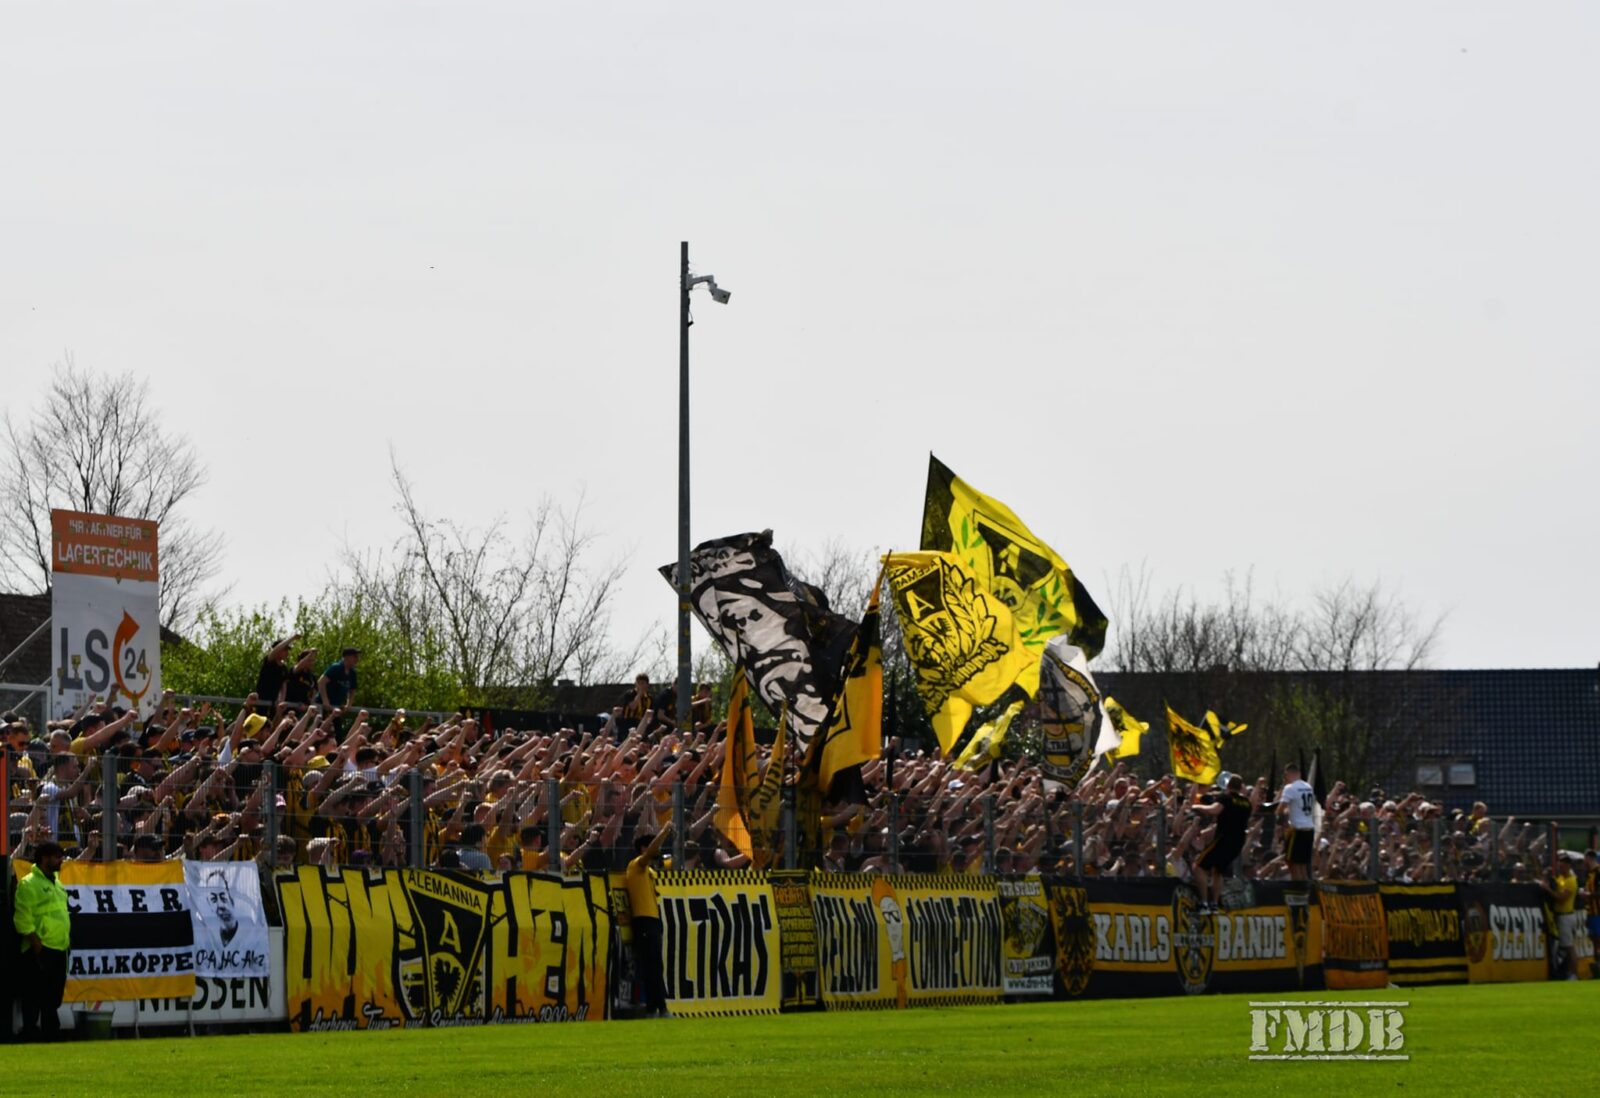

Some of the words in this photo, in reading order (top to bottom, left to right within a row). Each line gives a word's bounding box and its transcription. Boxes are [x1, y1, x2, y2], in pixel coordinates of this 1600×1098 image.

[125, 524, 142, 541] FÜR
[58, 542, 153, 571] LAGERTECHNIK
[61, 627, 110, 692] LS
[125, 647, 149, 680] 24
[66, 888, 182, 912] CHER
[407, 872, 483, 911] ALEMANNIA
[439, 909, 461, 954] A
[907, 897, 1001, 989] CONNECTION
[1093, 912, 1170, 962] KARLS
[1218, 913, 1286, 960] BANDE
[1489, 903, 1545, 961] SZENE
[70, 952, 193, 975] ALLKÖPPE
